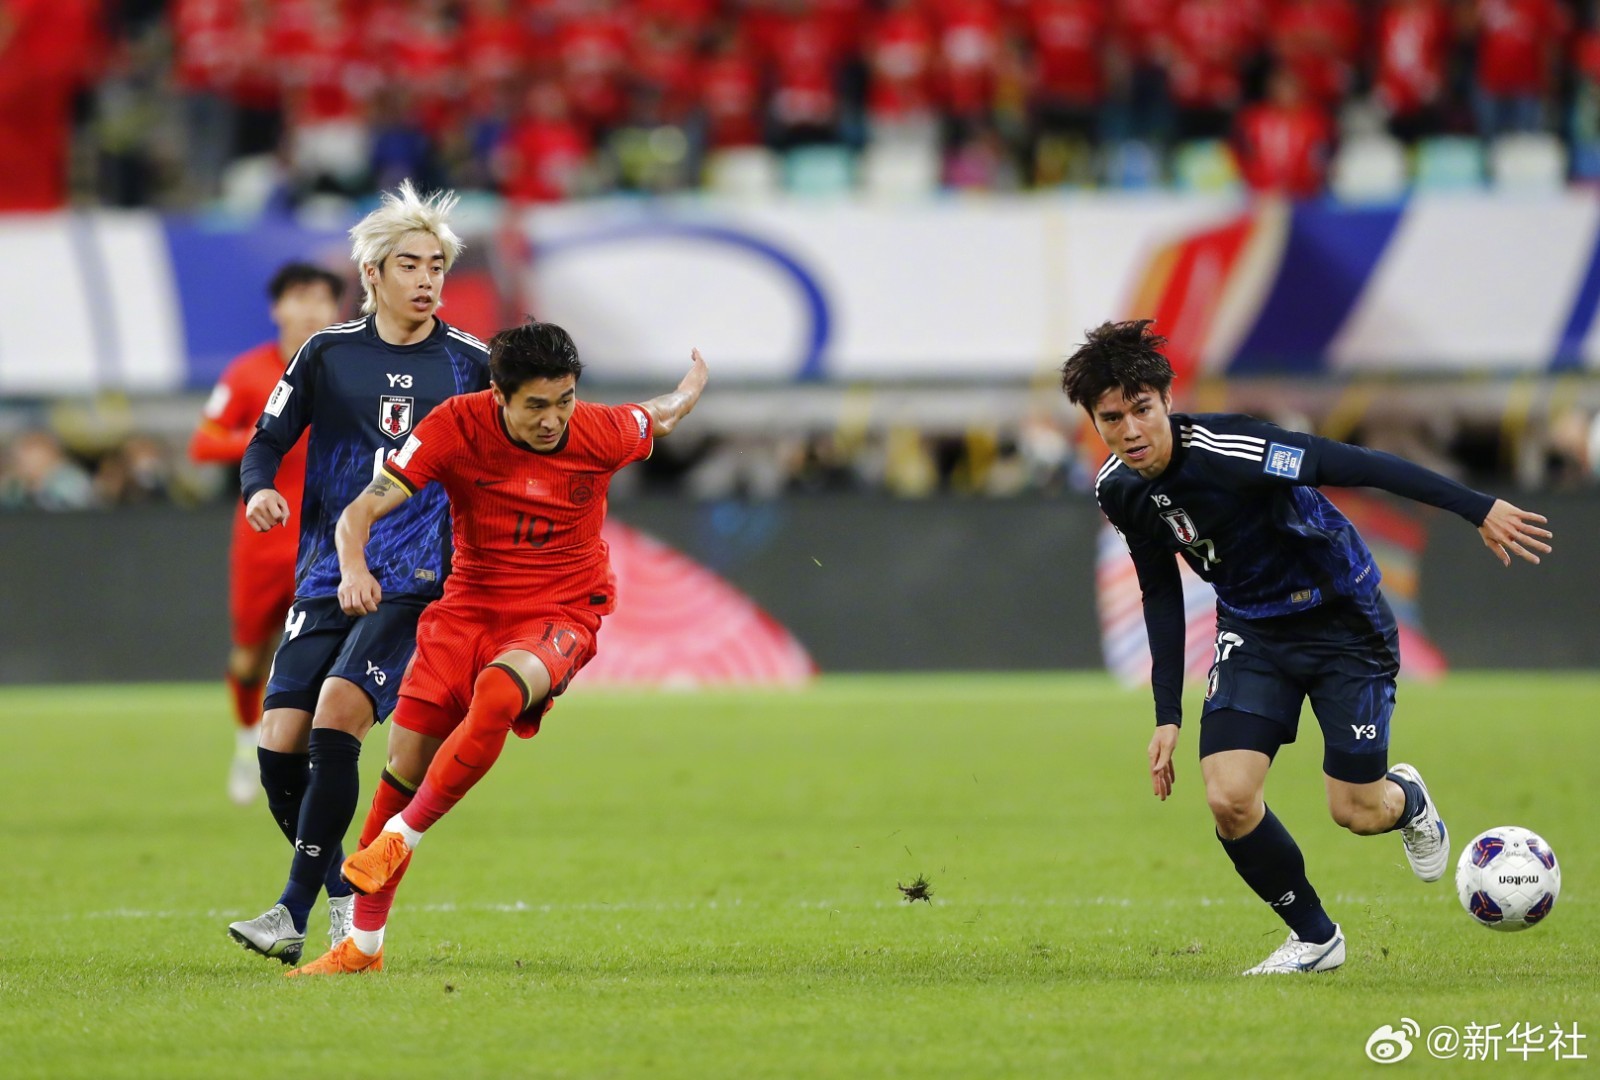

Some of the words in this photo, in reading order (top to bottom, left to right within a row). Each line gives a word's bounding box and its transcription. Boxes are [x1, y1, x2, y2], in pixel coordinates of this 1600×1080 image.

[386, 373, 414, 389] Y-3
[1150, 494, 1172, 508] Y-3
[512, 510, 555, 549] 10
[540, 621, 578, 659] 10
[365, 660, 387, 687] Y-3
[1350, 724, 1377, 740] Y-3
[1498, 875, 1540, 886] molten
